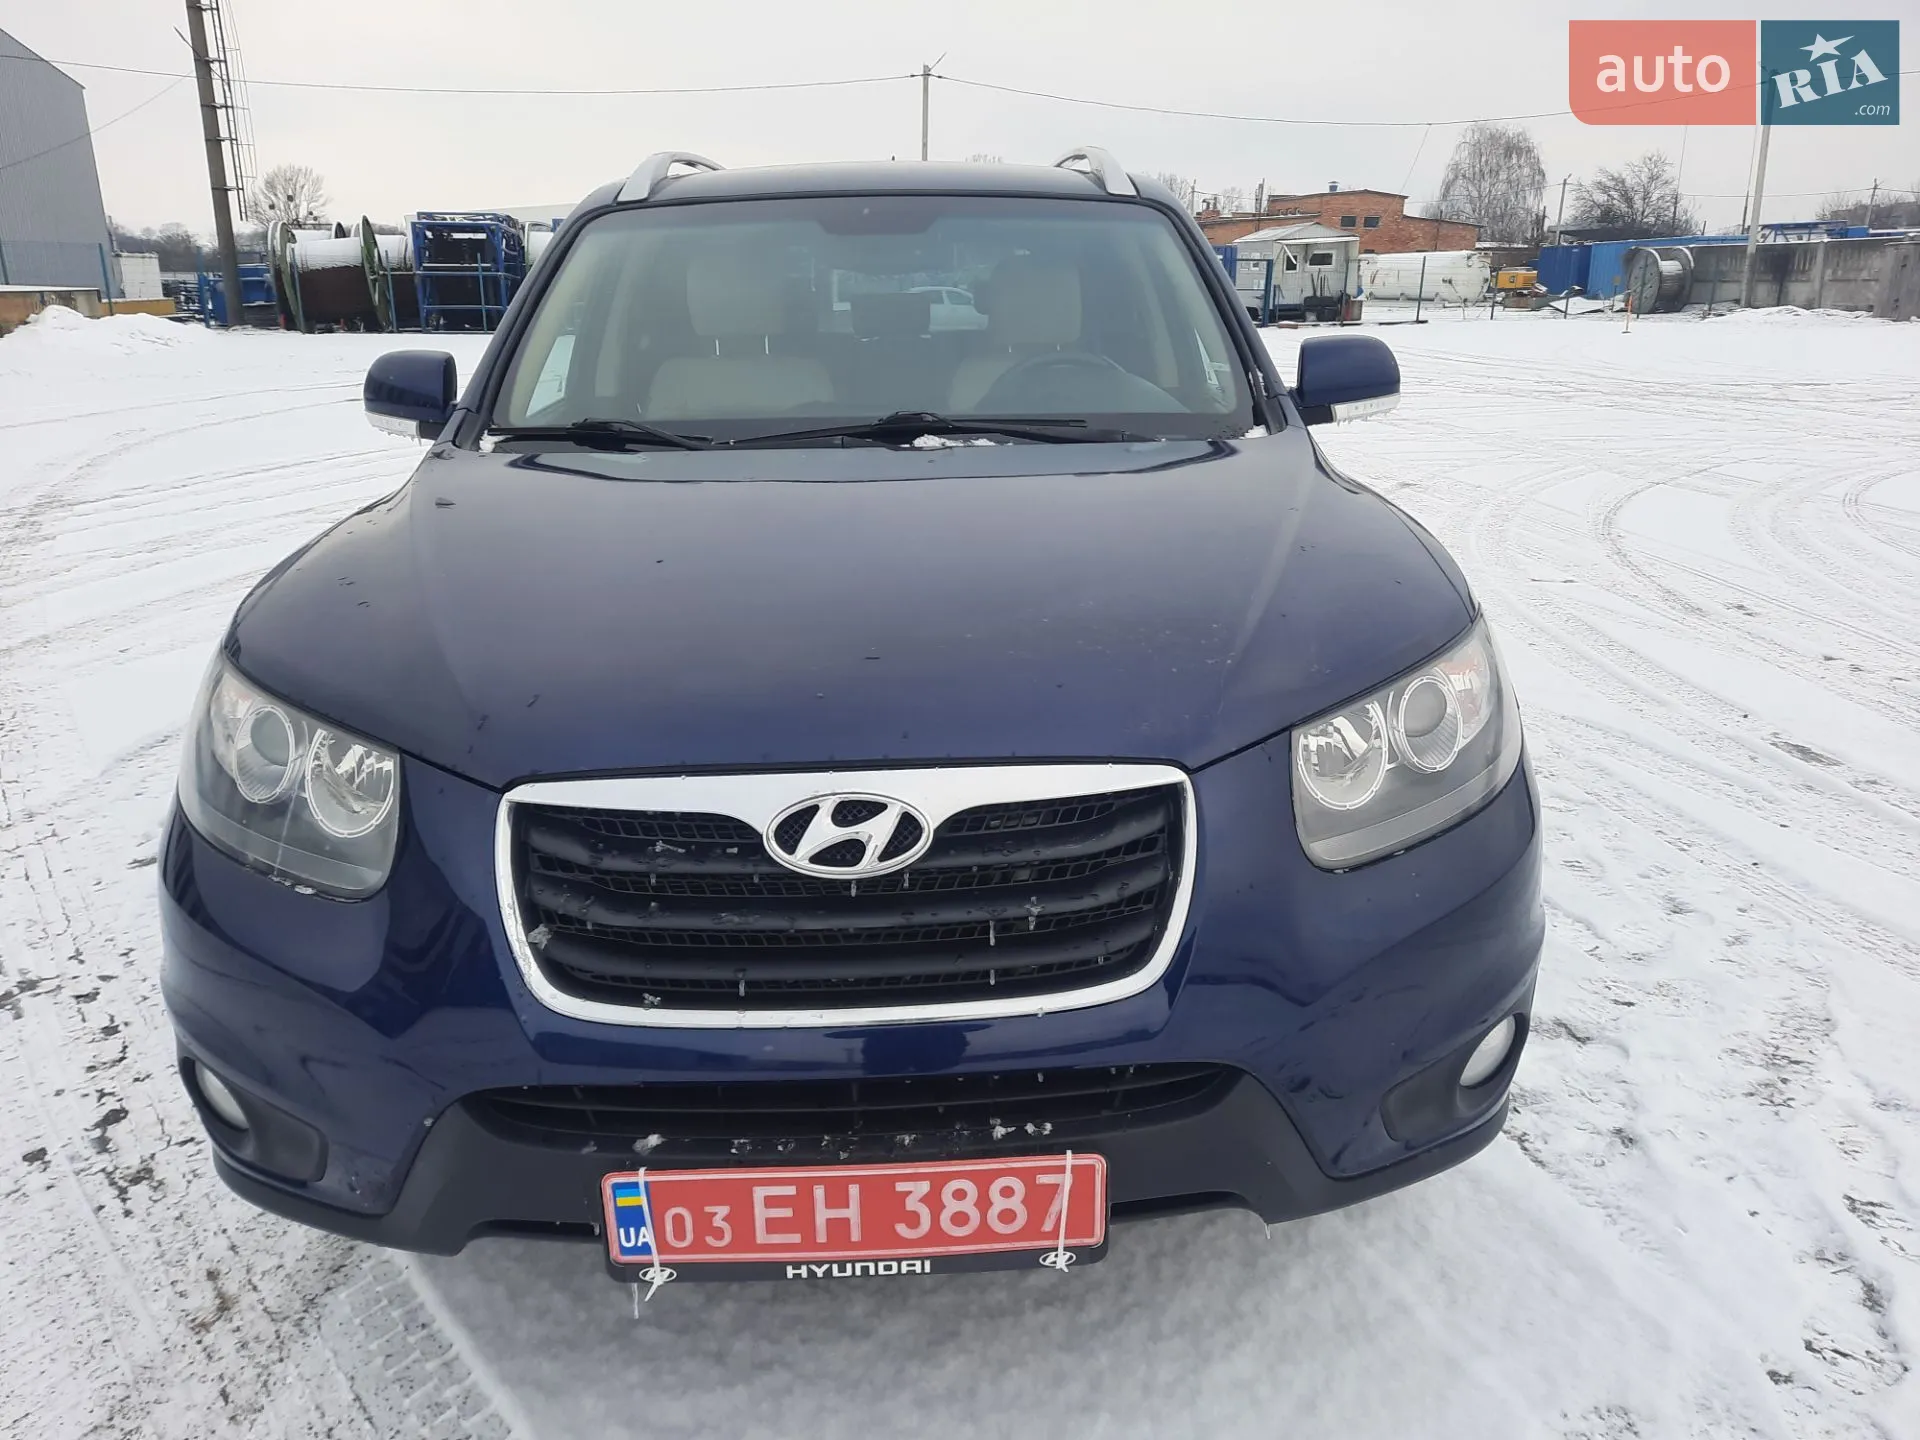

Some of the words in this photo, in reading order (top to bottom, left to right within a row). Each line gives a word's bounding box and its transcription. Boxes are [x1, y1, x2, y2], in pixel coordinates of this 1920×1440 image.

[664, 1205, 733, 1248] 03
[752, 1184, 861, 1244] EH
[894, 1173, 1073, 1239] 3887
[619, 1226, 652, 1248] UA
[785, 1260, 932, 1279] HYUNDAI
